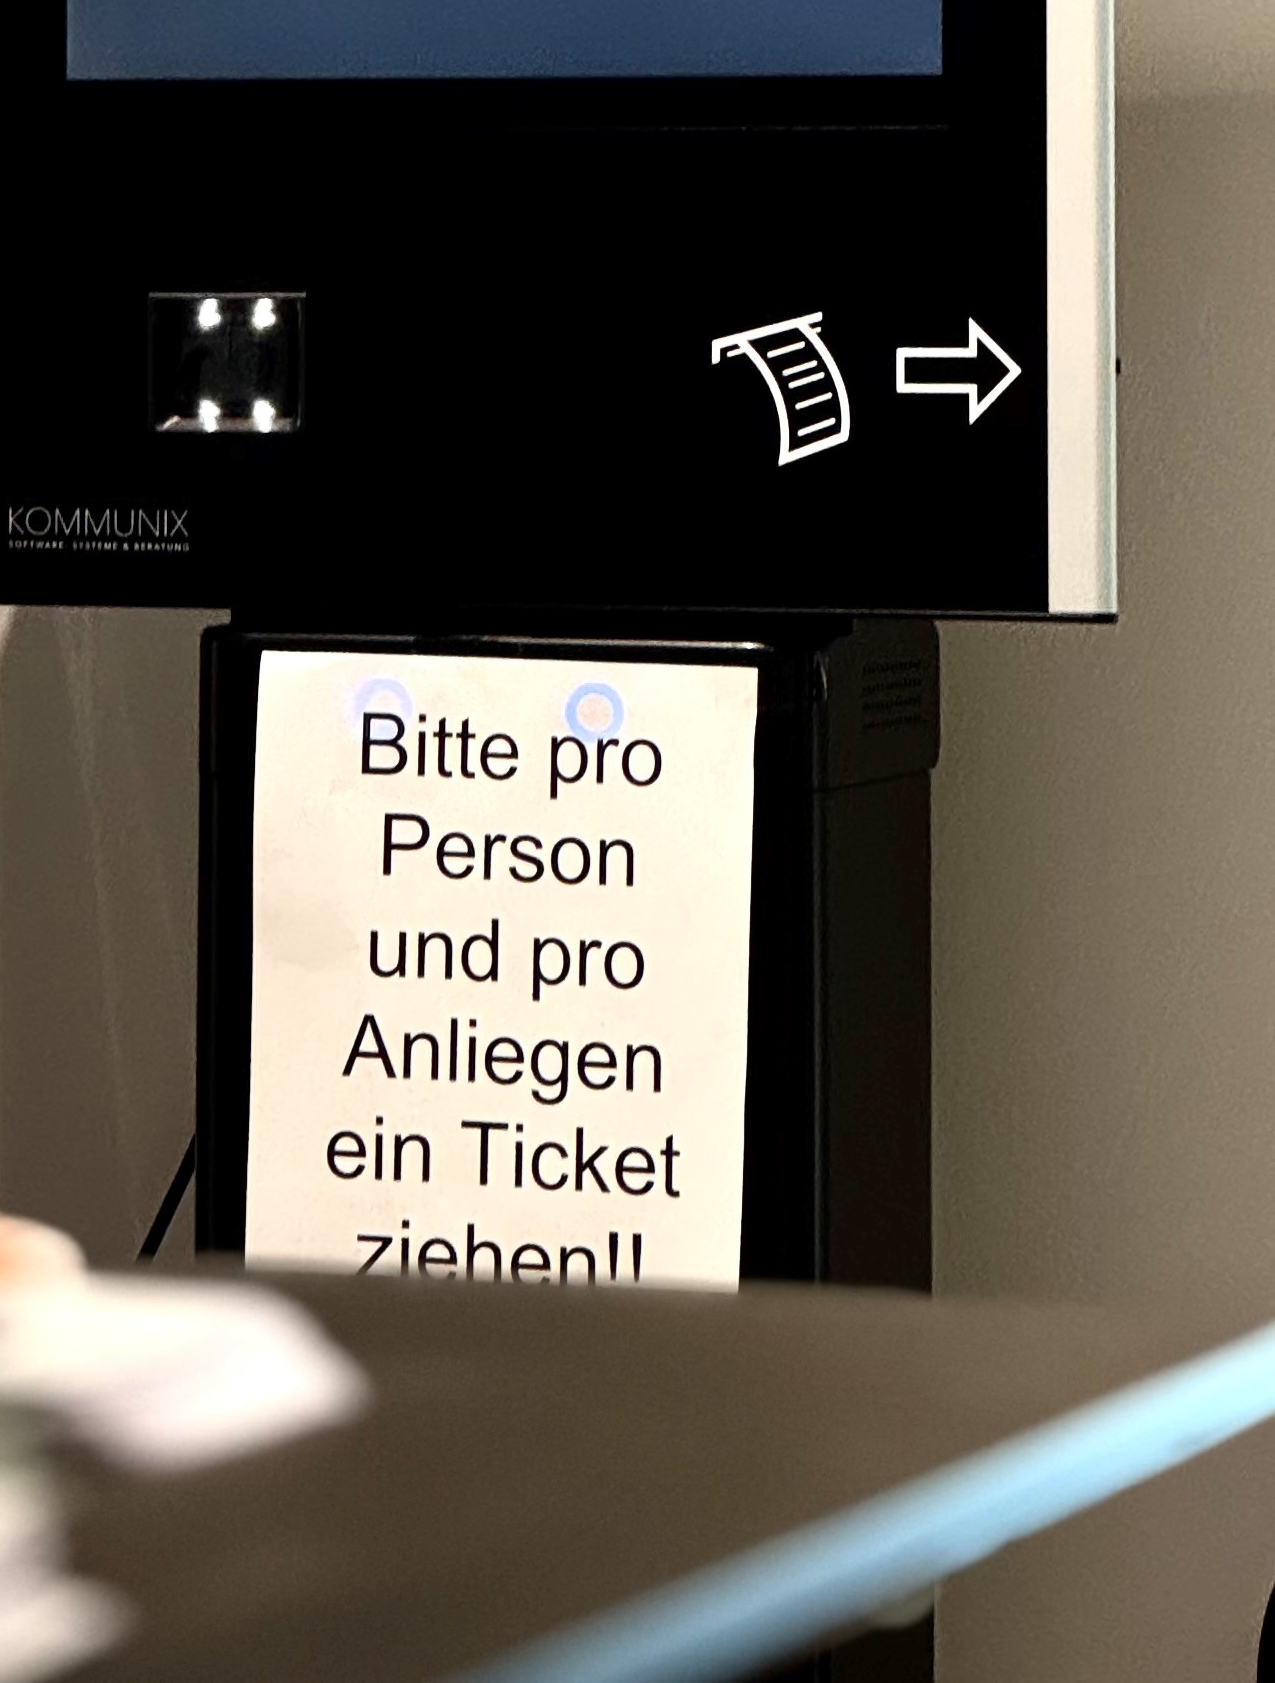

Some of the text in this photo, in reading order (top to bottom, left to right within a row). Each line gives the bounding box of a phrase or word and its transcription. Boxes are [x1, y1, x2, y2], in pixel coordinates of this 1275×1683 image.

[8, 506, 189, 538] KOMMUNIX
[133, 542, 190, 552] BERATUNG
[361, 711, 662, 800] Bitte pro
[382, 812, 634, 887] Person
[369, 918, 645, 1002] und pro
[342, 1013, 662, 1106] Anliegen
[326, 1116, 681, 1198] ein Ticket
[355, 1219, 642, 1285] ziehen!!
